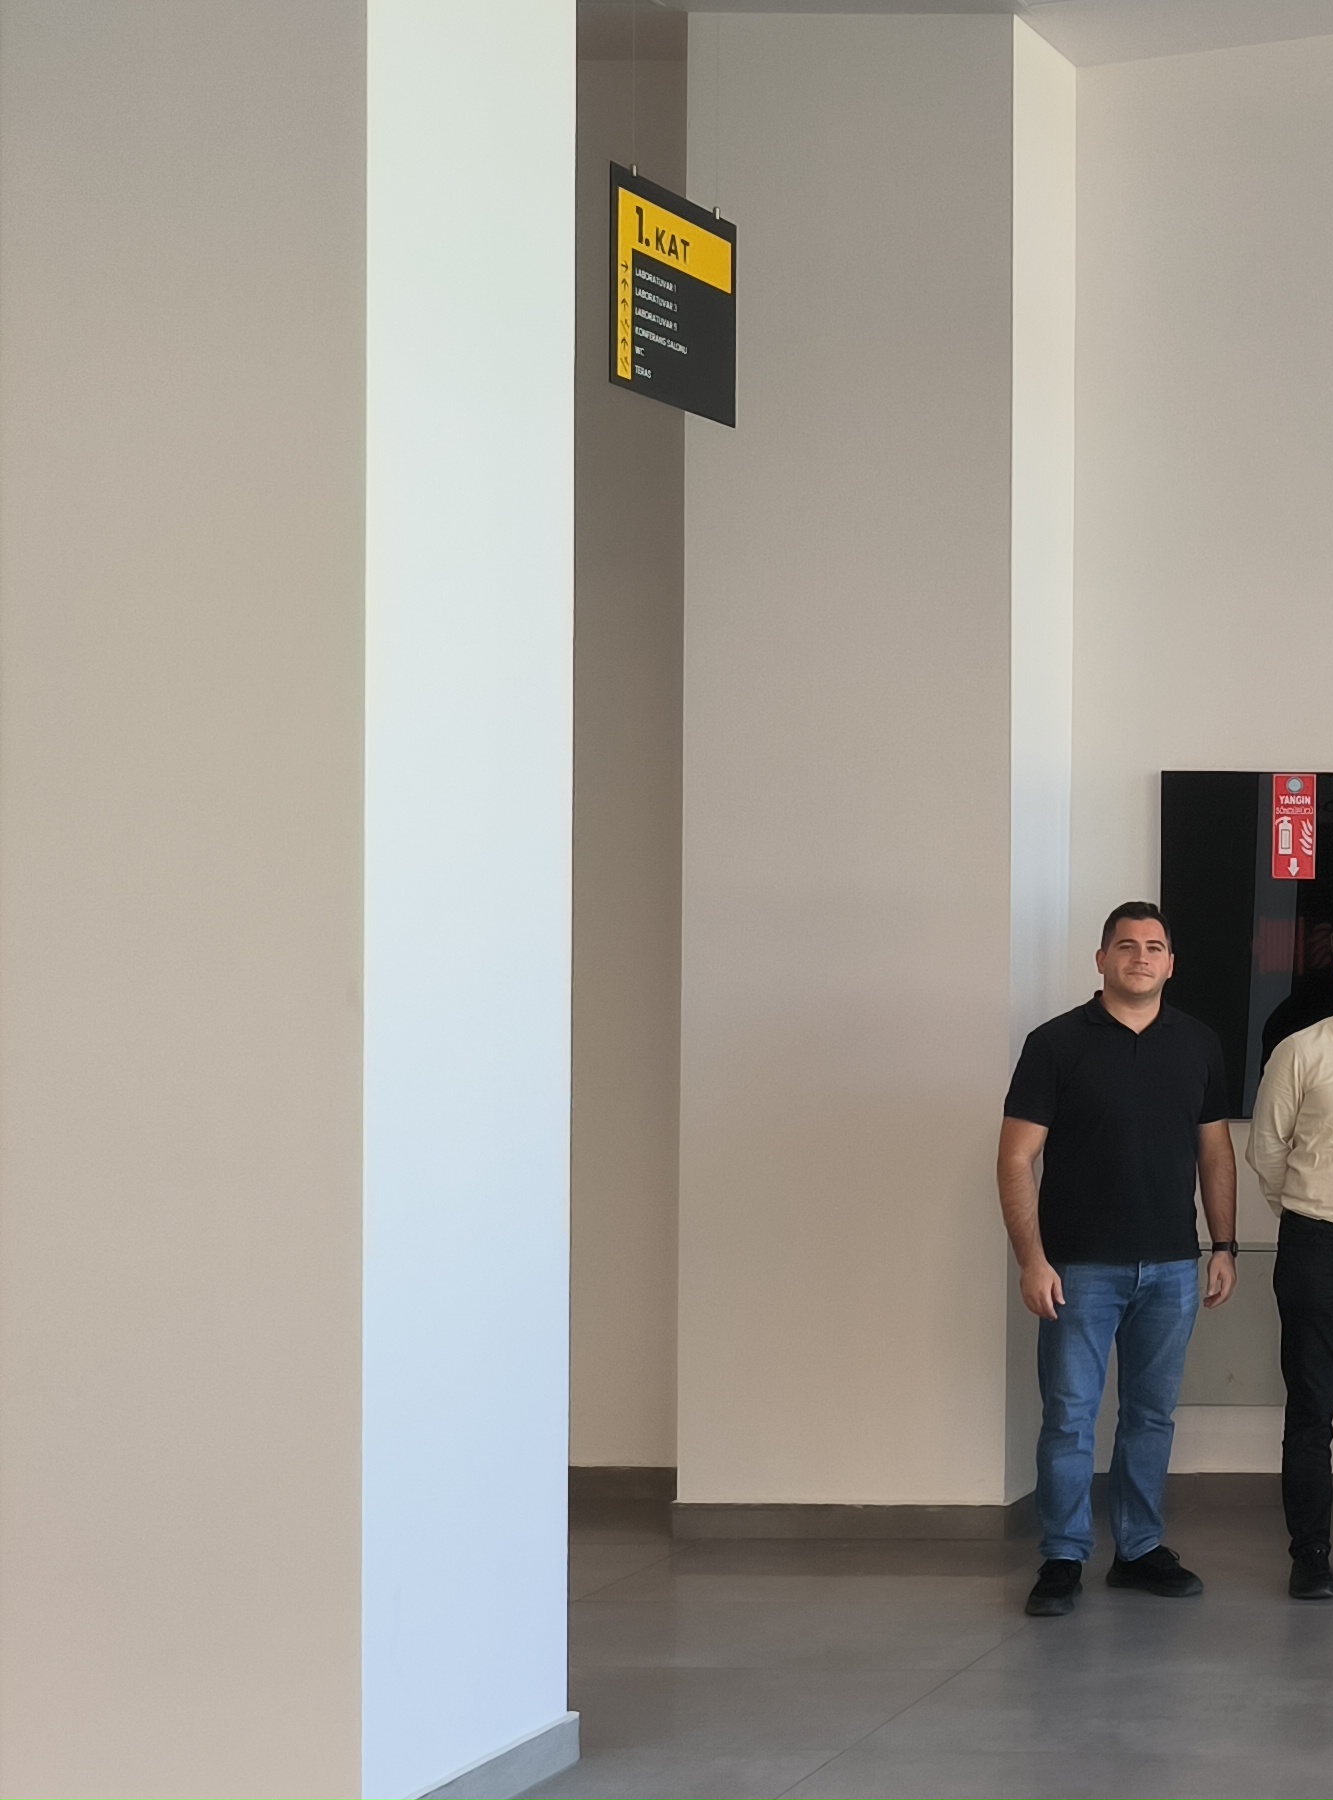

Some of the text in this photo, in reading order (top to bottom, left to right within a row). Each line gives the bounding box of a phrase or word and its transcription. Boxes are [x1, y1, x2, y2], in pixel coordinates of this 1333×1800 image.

[635, 205, 690, 265] 1. KAT
[1278, 794, 1312, 806] YANGIN
